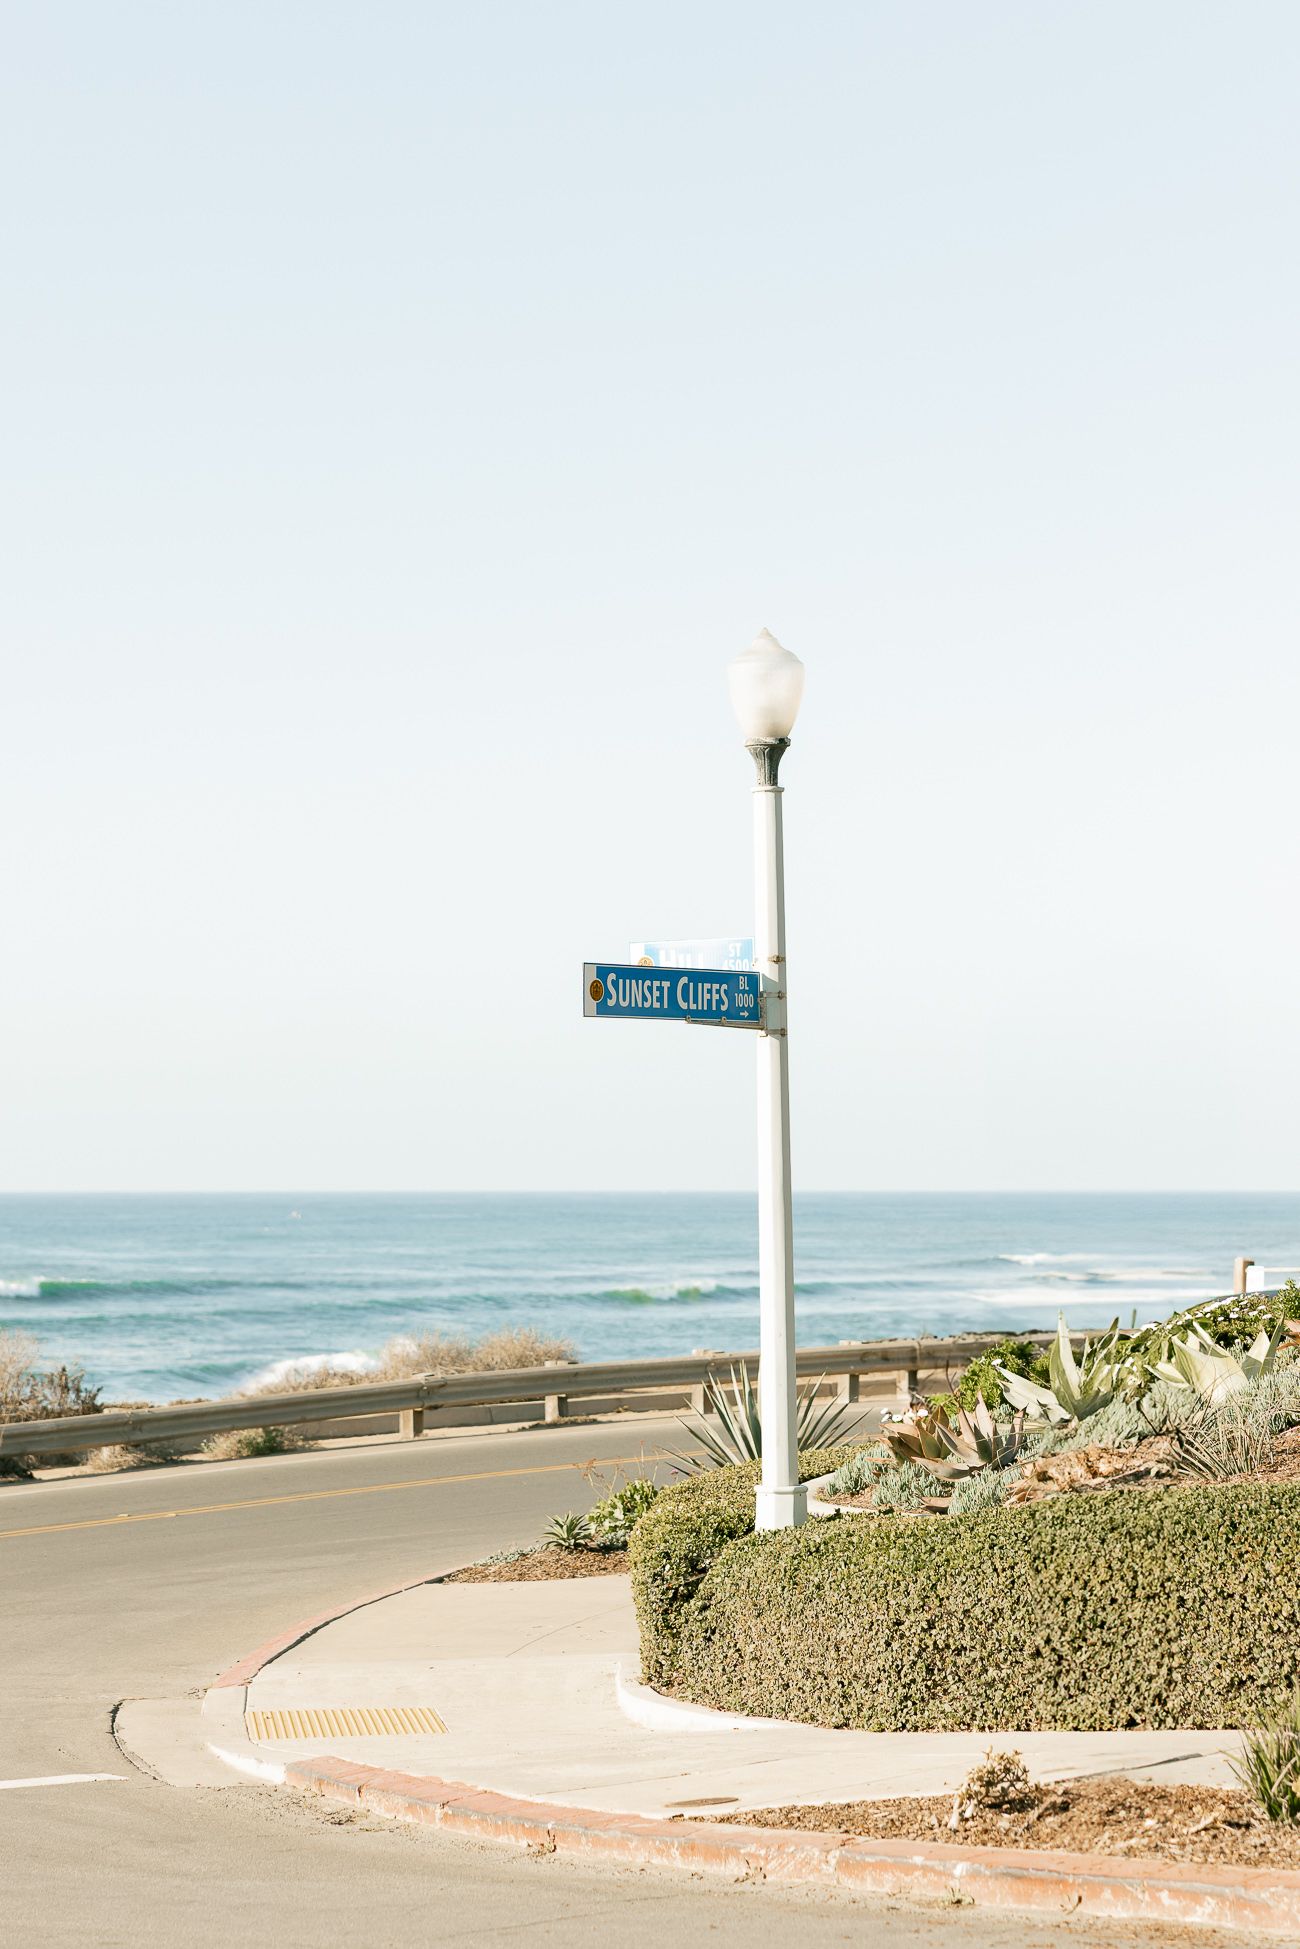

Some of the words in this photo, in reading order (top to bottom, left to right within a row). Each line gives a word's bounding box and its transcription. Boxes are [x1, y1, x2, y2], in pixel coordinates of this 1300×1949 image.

[728, 942, 742, 956] ST
[739, 975, 749, 991] BL
[606, 972, 671, 1009] SUNSET
[676, 976, 729, 1012] CLIFFS
[735, 993, 754, 1008] 1000
